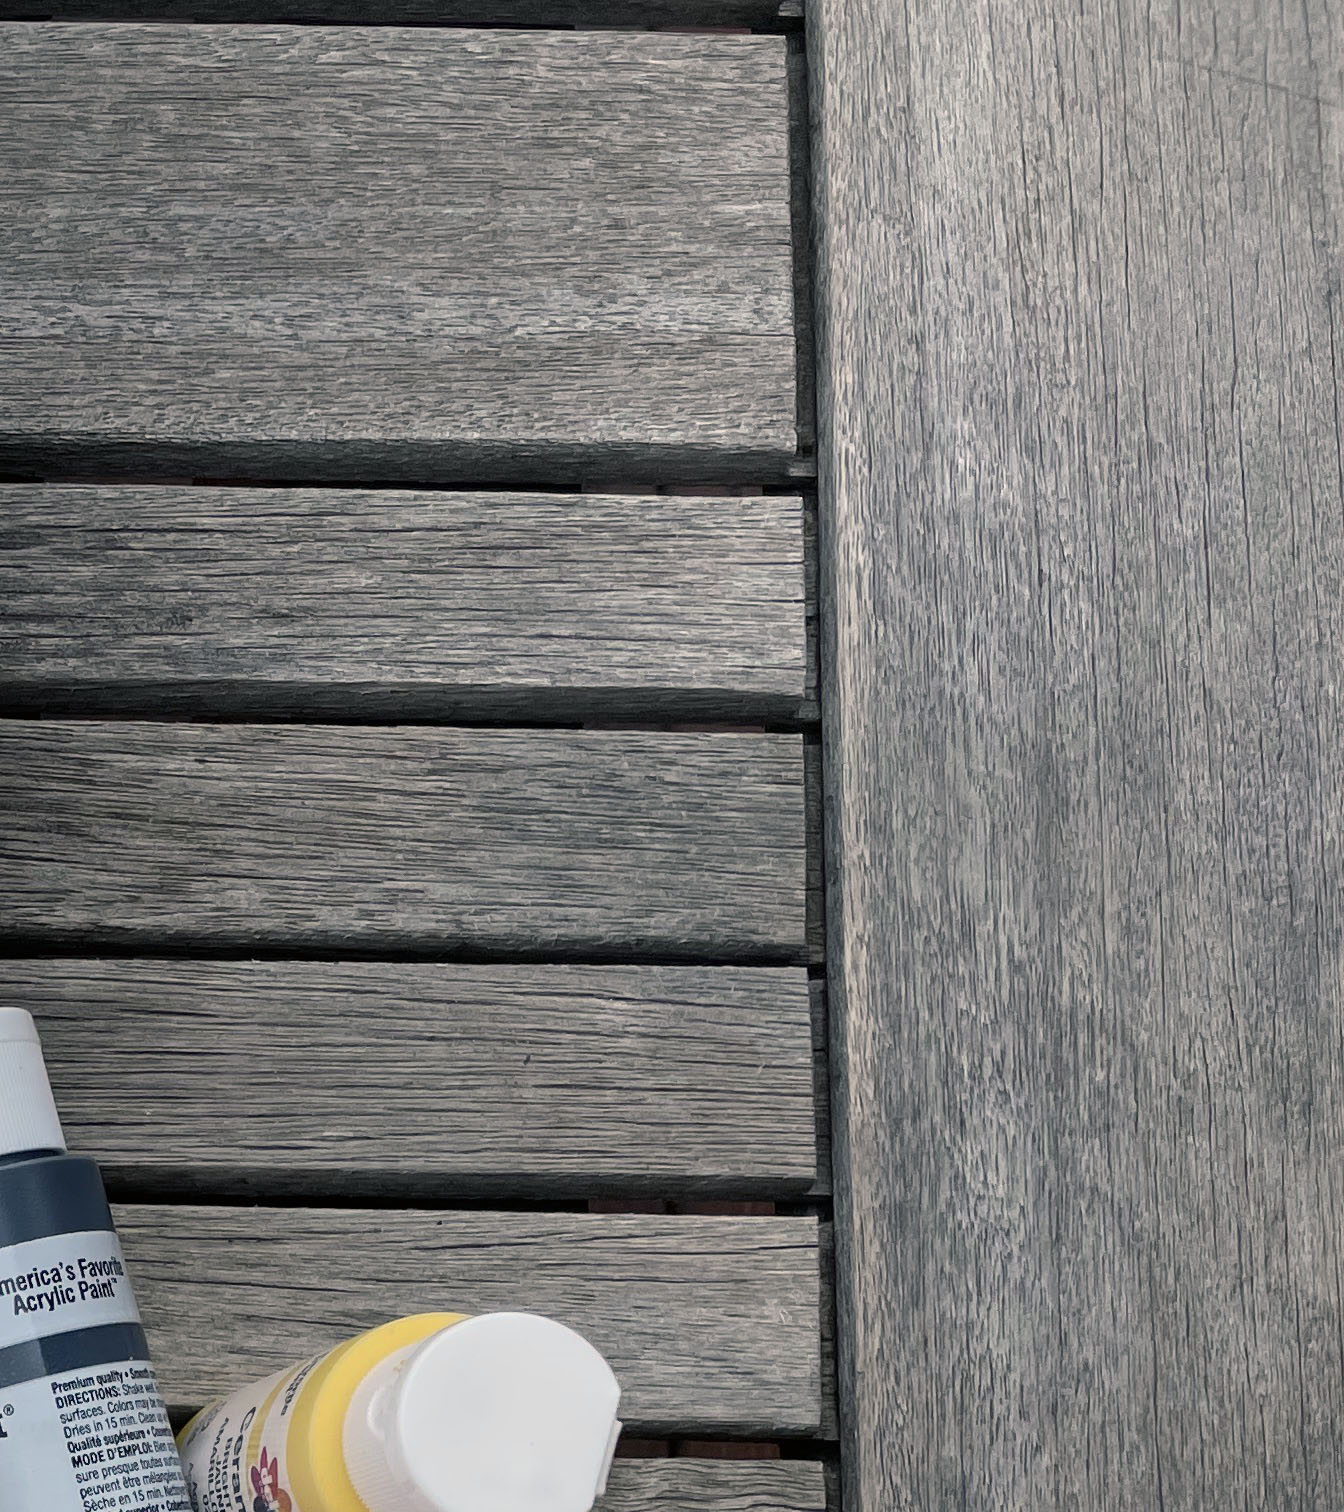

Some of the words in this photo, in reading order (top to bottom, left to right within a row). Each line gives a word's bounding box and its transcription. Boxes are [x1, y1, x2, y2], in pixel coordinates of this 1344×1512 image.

[14, 1287, 76, 1316] Acrylic
[51, 1375, 95, 1394] Premium
[96, 1369, 123, 1386] quality
[55, 1385, 121, 1409] DIRECTIONS:
[59, 1406, 105, 1424] surfaces.
[107, 1399, 135, 1414] Colors
[63, 1424, 91, 1438] Dries
[105, 1417, 118, 1430] 15
[67, 1434, 102, 1453] Qualité
[71, 1450, 106, 1468] MODE
[75, 1470, 99, 1483] sure
[101, 1461, 140, 1480] presque
[140, 1456, 163, 1469] toutes
[220, 1436, 233, 1511] BRIGHT
[79, 1480, 122, 1500] peuvent
[83, 1496, 117, 1512] Sèche
[119, 1495, 132, 1505] en
[132, 1490, 145, 1502] 15
